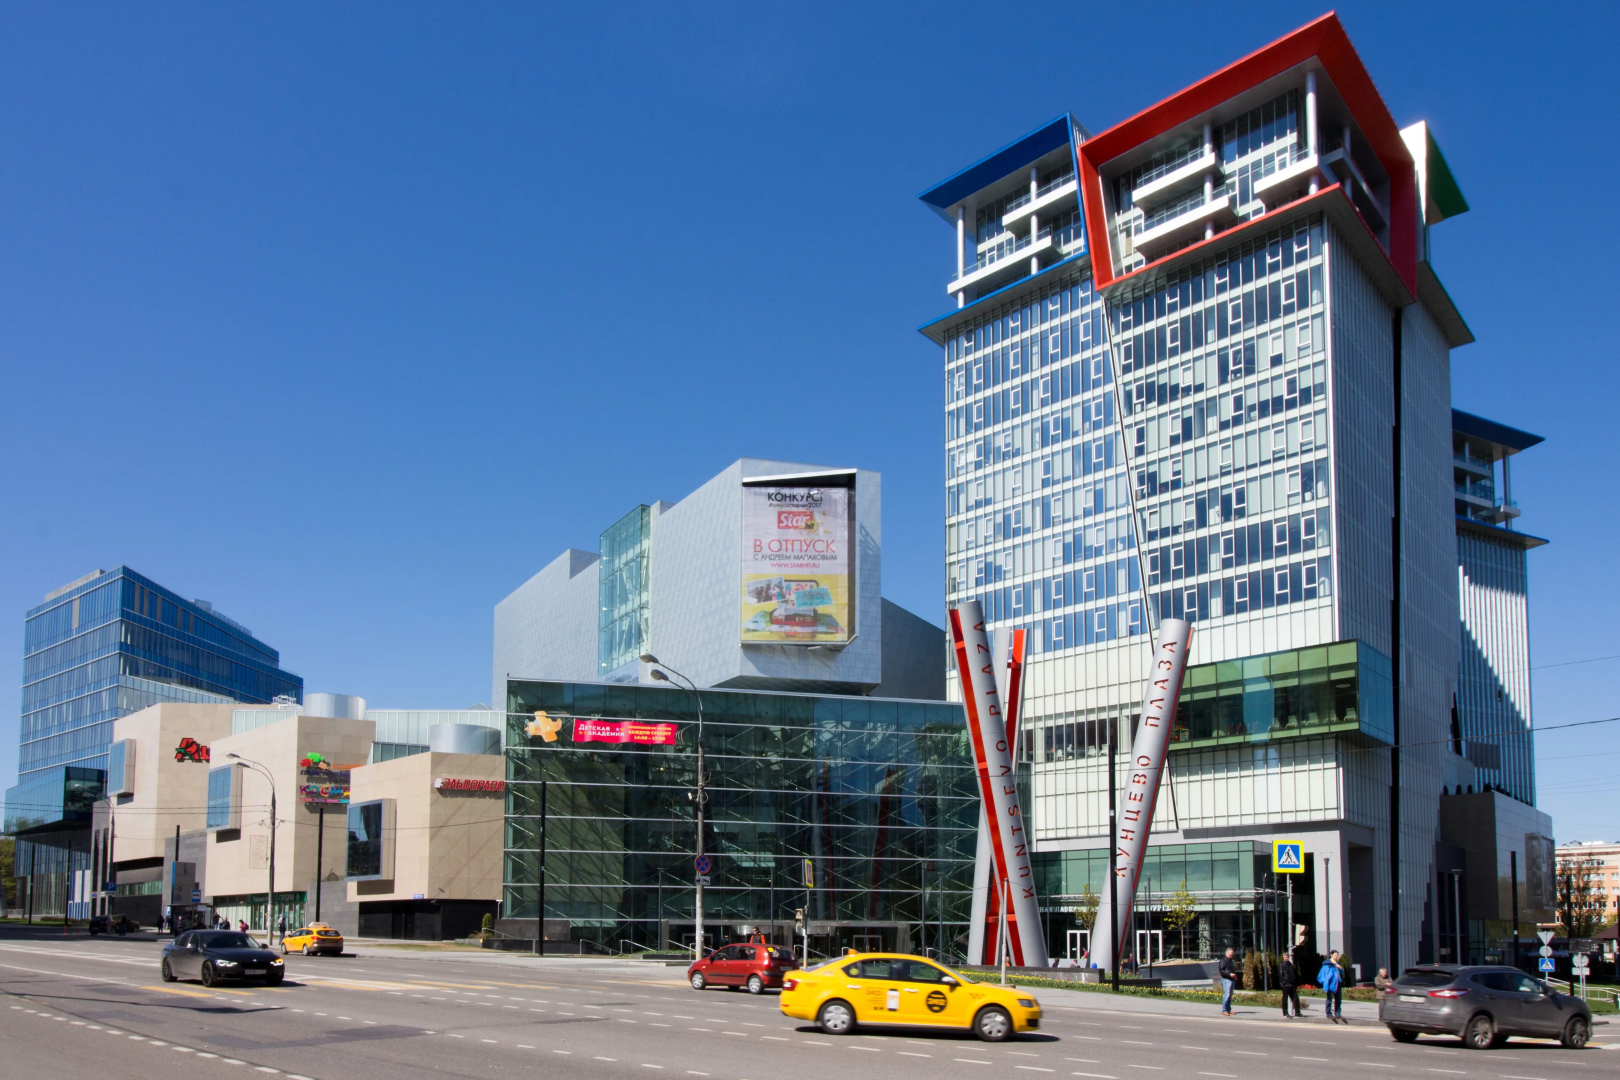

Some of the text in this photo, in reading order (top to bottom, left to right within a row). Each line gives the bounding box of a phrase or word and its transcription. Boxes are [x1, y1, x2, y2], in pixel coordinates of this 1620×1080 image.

[779, 513, 811, 527] Star
[753, 539, 836, 553] В ОТПУСК
[1145, 640, 1177, 728] ПЛАЗА
[973, 620, 1035, 899] KUNTSEVO PLAZA
